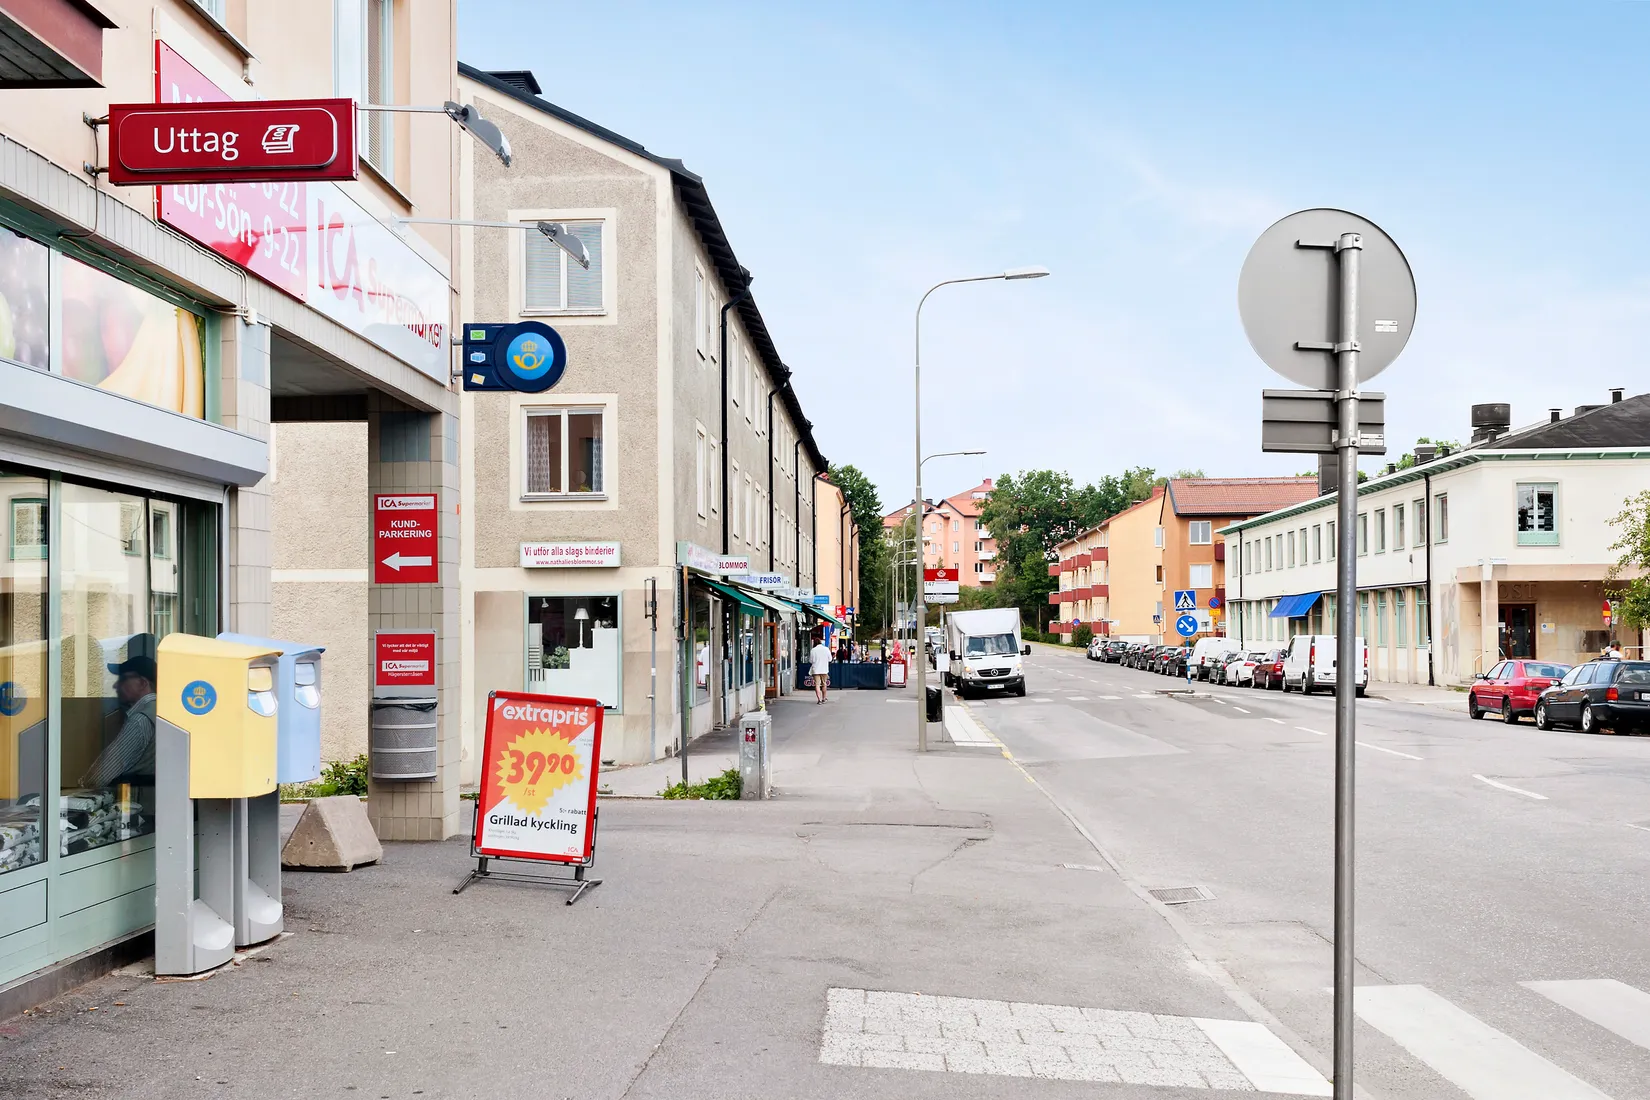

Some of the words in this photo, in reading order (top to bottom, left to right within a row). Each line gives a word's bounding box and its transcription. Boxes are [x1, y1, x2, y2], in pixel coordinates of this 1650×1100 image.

[153, 127, 239, 161] Uttag
[317, 198, 365, 314] ICA
[381, 499, 397, 508] ICA
[391, 520, 420, 528] KUND-
[379, 530, 432, 538] PARKERING
[524, 547, 532, 556] Vi
[551, 547, 564, 556] alla
[565, 546, 583, 557] slags
[489, 814, 528, 828] Grillad
[530, 817, 577, 835] kyckling
